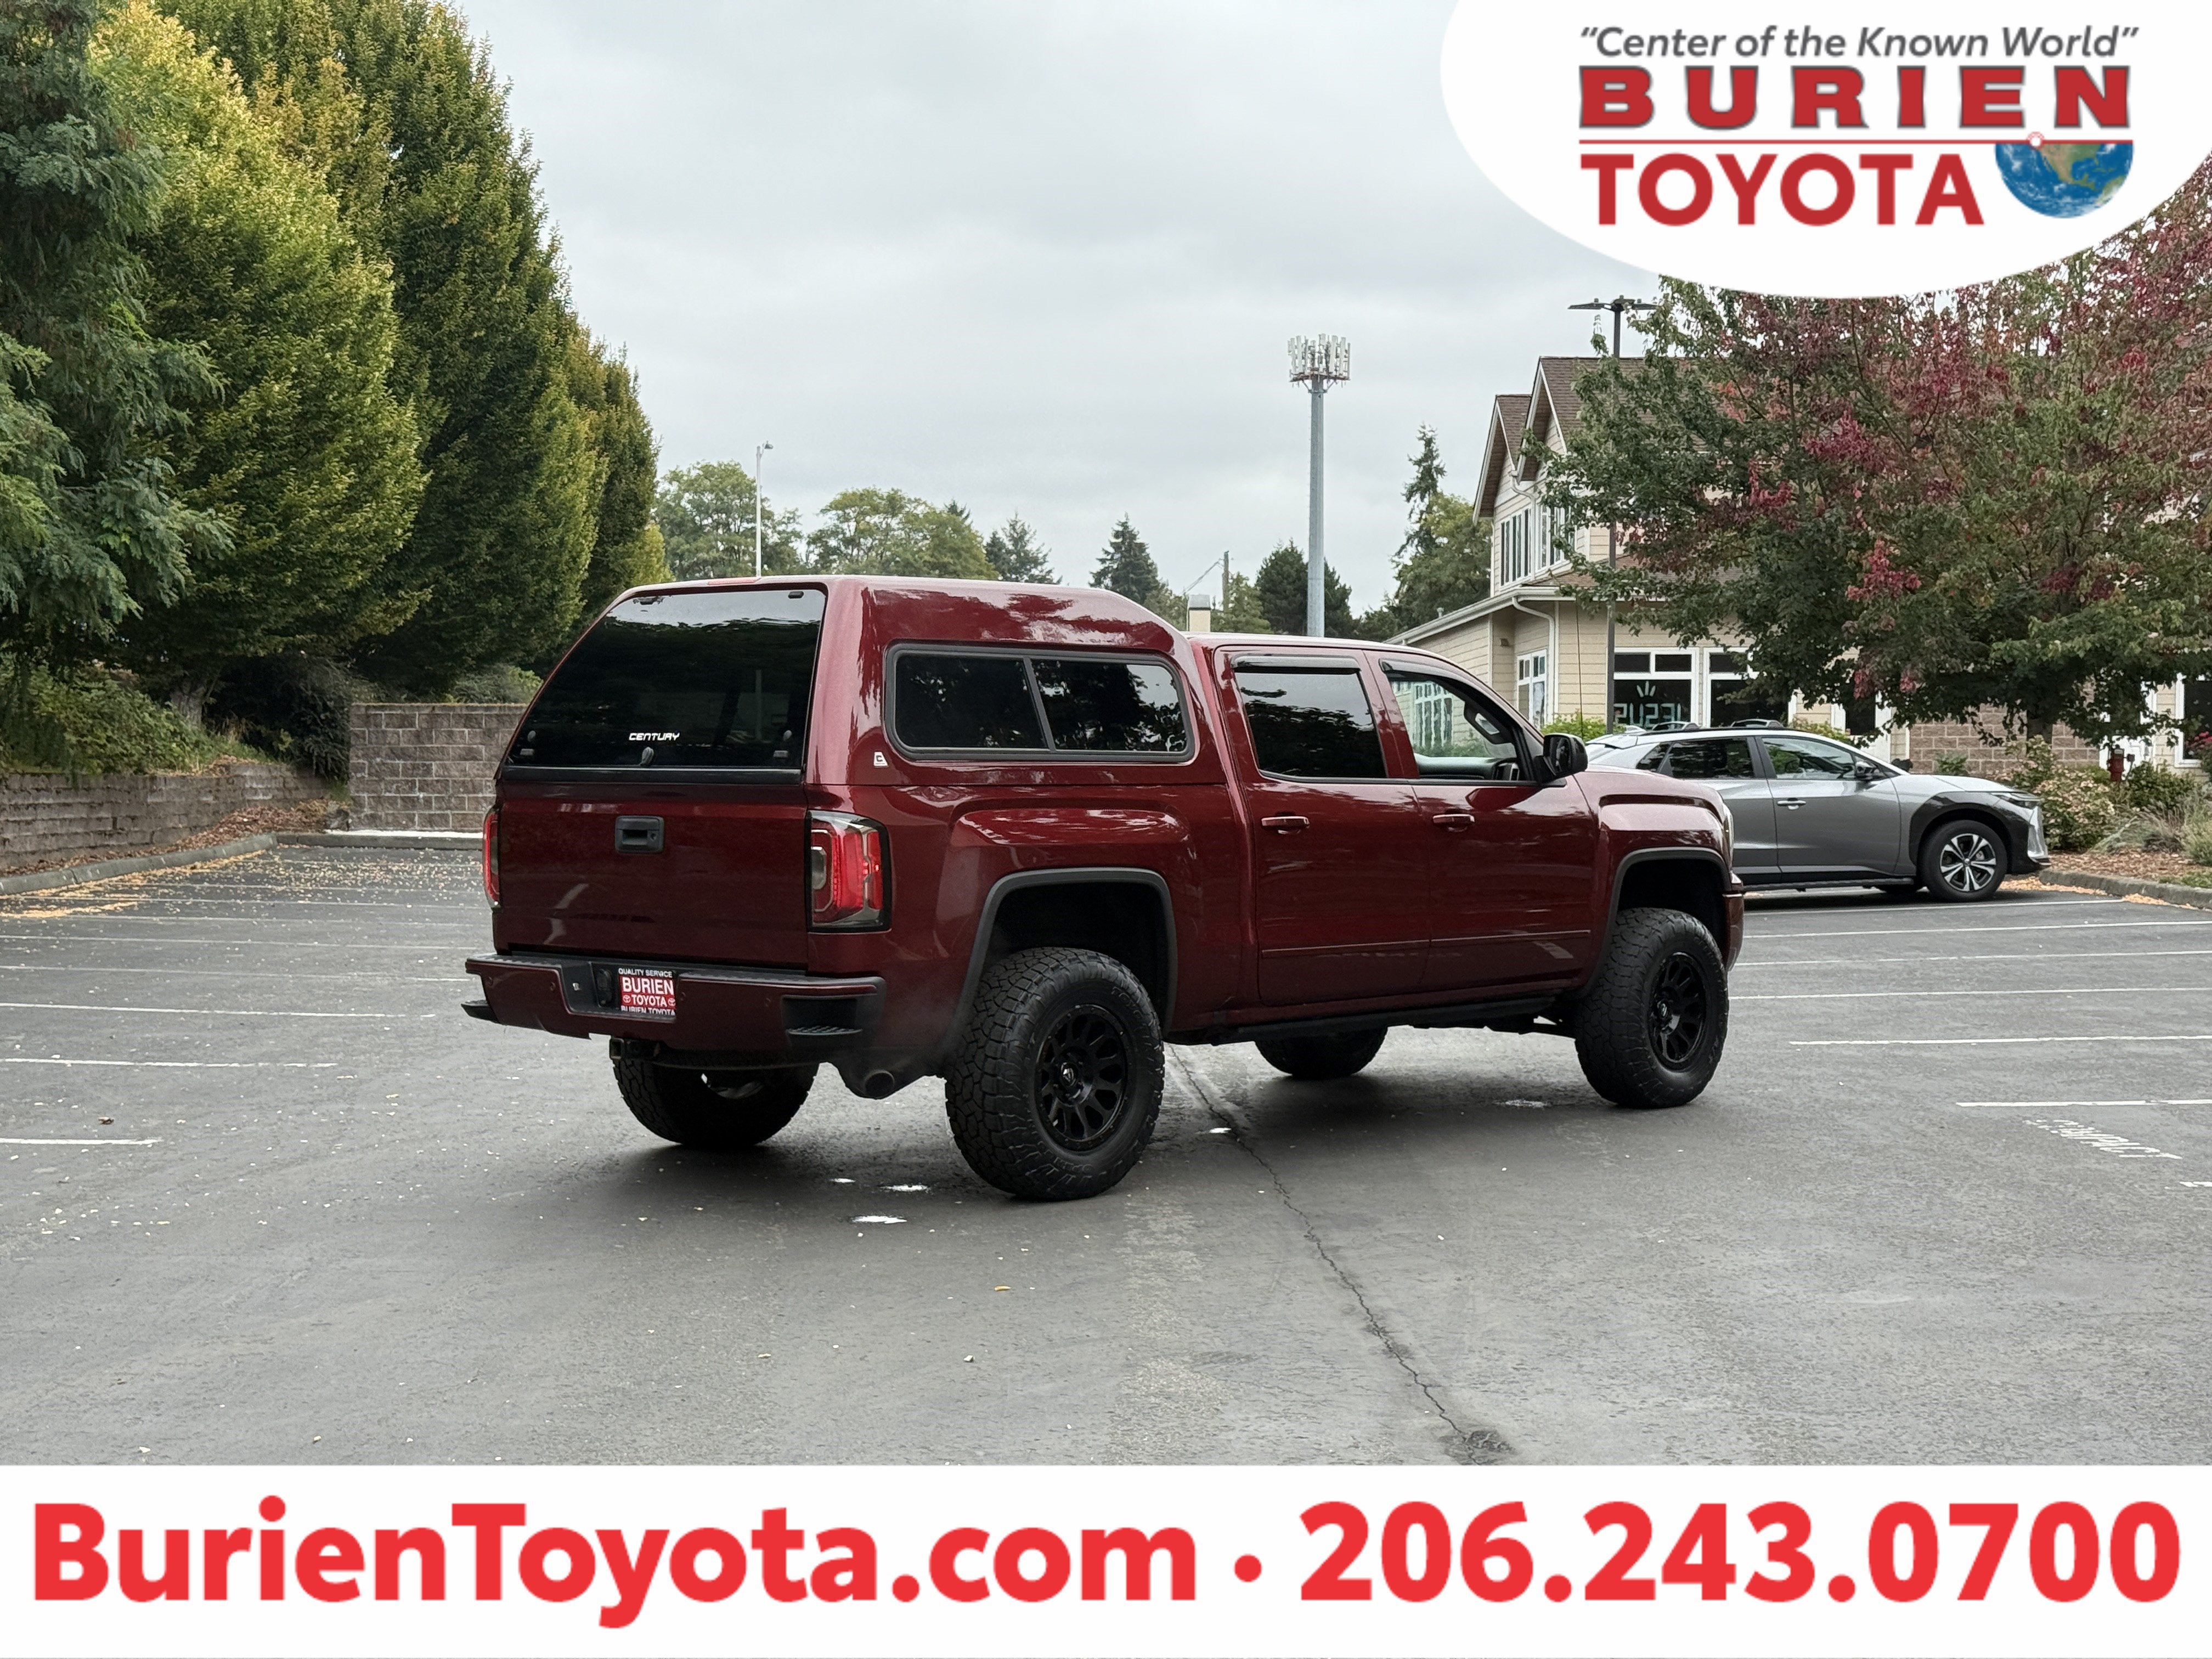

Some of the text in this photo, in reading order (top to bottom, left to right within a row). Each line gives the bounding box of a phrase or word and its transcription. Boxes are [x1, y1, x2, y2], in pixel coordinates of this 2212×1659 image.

[629, 732, 680, 741] CENTURY
[618, 968, 673, 978] QUALITY SERVICE
[622, 977, 675, 995] BURIEN
[631, 994, 668, 1007] TOYOTA
[620, 1005, 676, 1016] BURIEN TOYOTA
